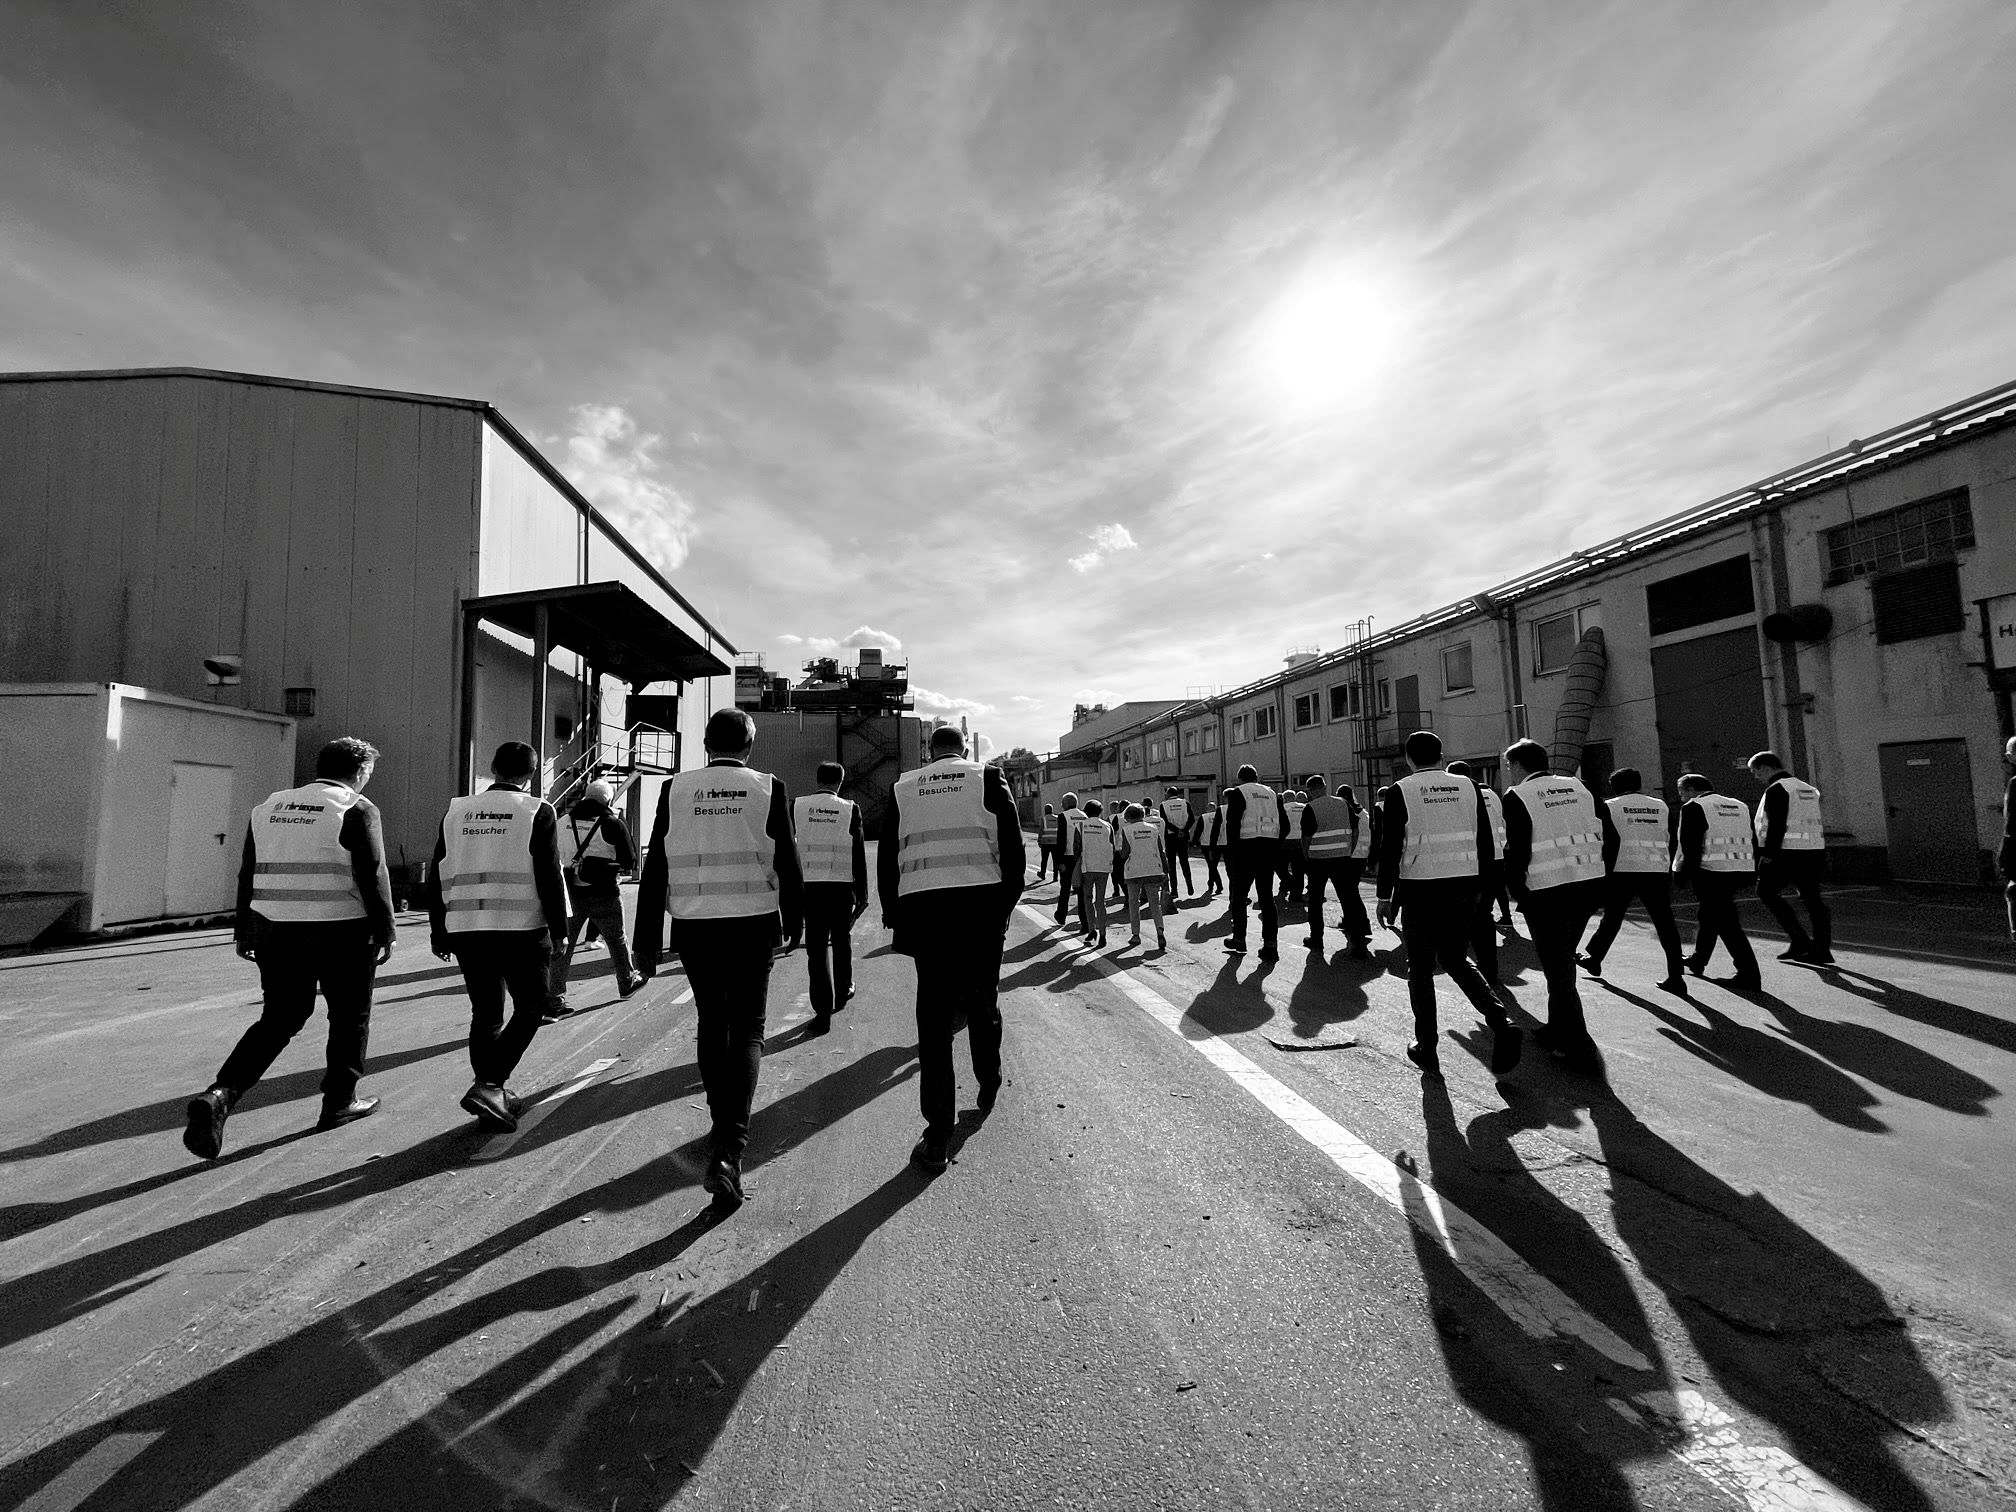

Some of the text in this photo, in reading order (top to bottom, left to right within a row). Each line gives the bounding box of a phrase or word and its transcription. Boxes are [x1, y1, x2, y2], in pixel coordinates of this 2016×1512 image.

[918, 785, 964, 797] Besucher
[1423, 796, 1460, 805] Besucher
[1544, 798, 1579, 809] Besucher
[694, 806, 744, 816] Besucher
[1623, 806, 1660, 815] Besucher
[269, 815, 317, 825] Besucher
[809, 816, 838, 824] Besucher
[462, 827, 507, 836] Besucher
